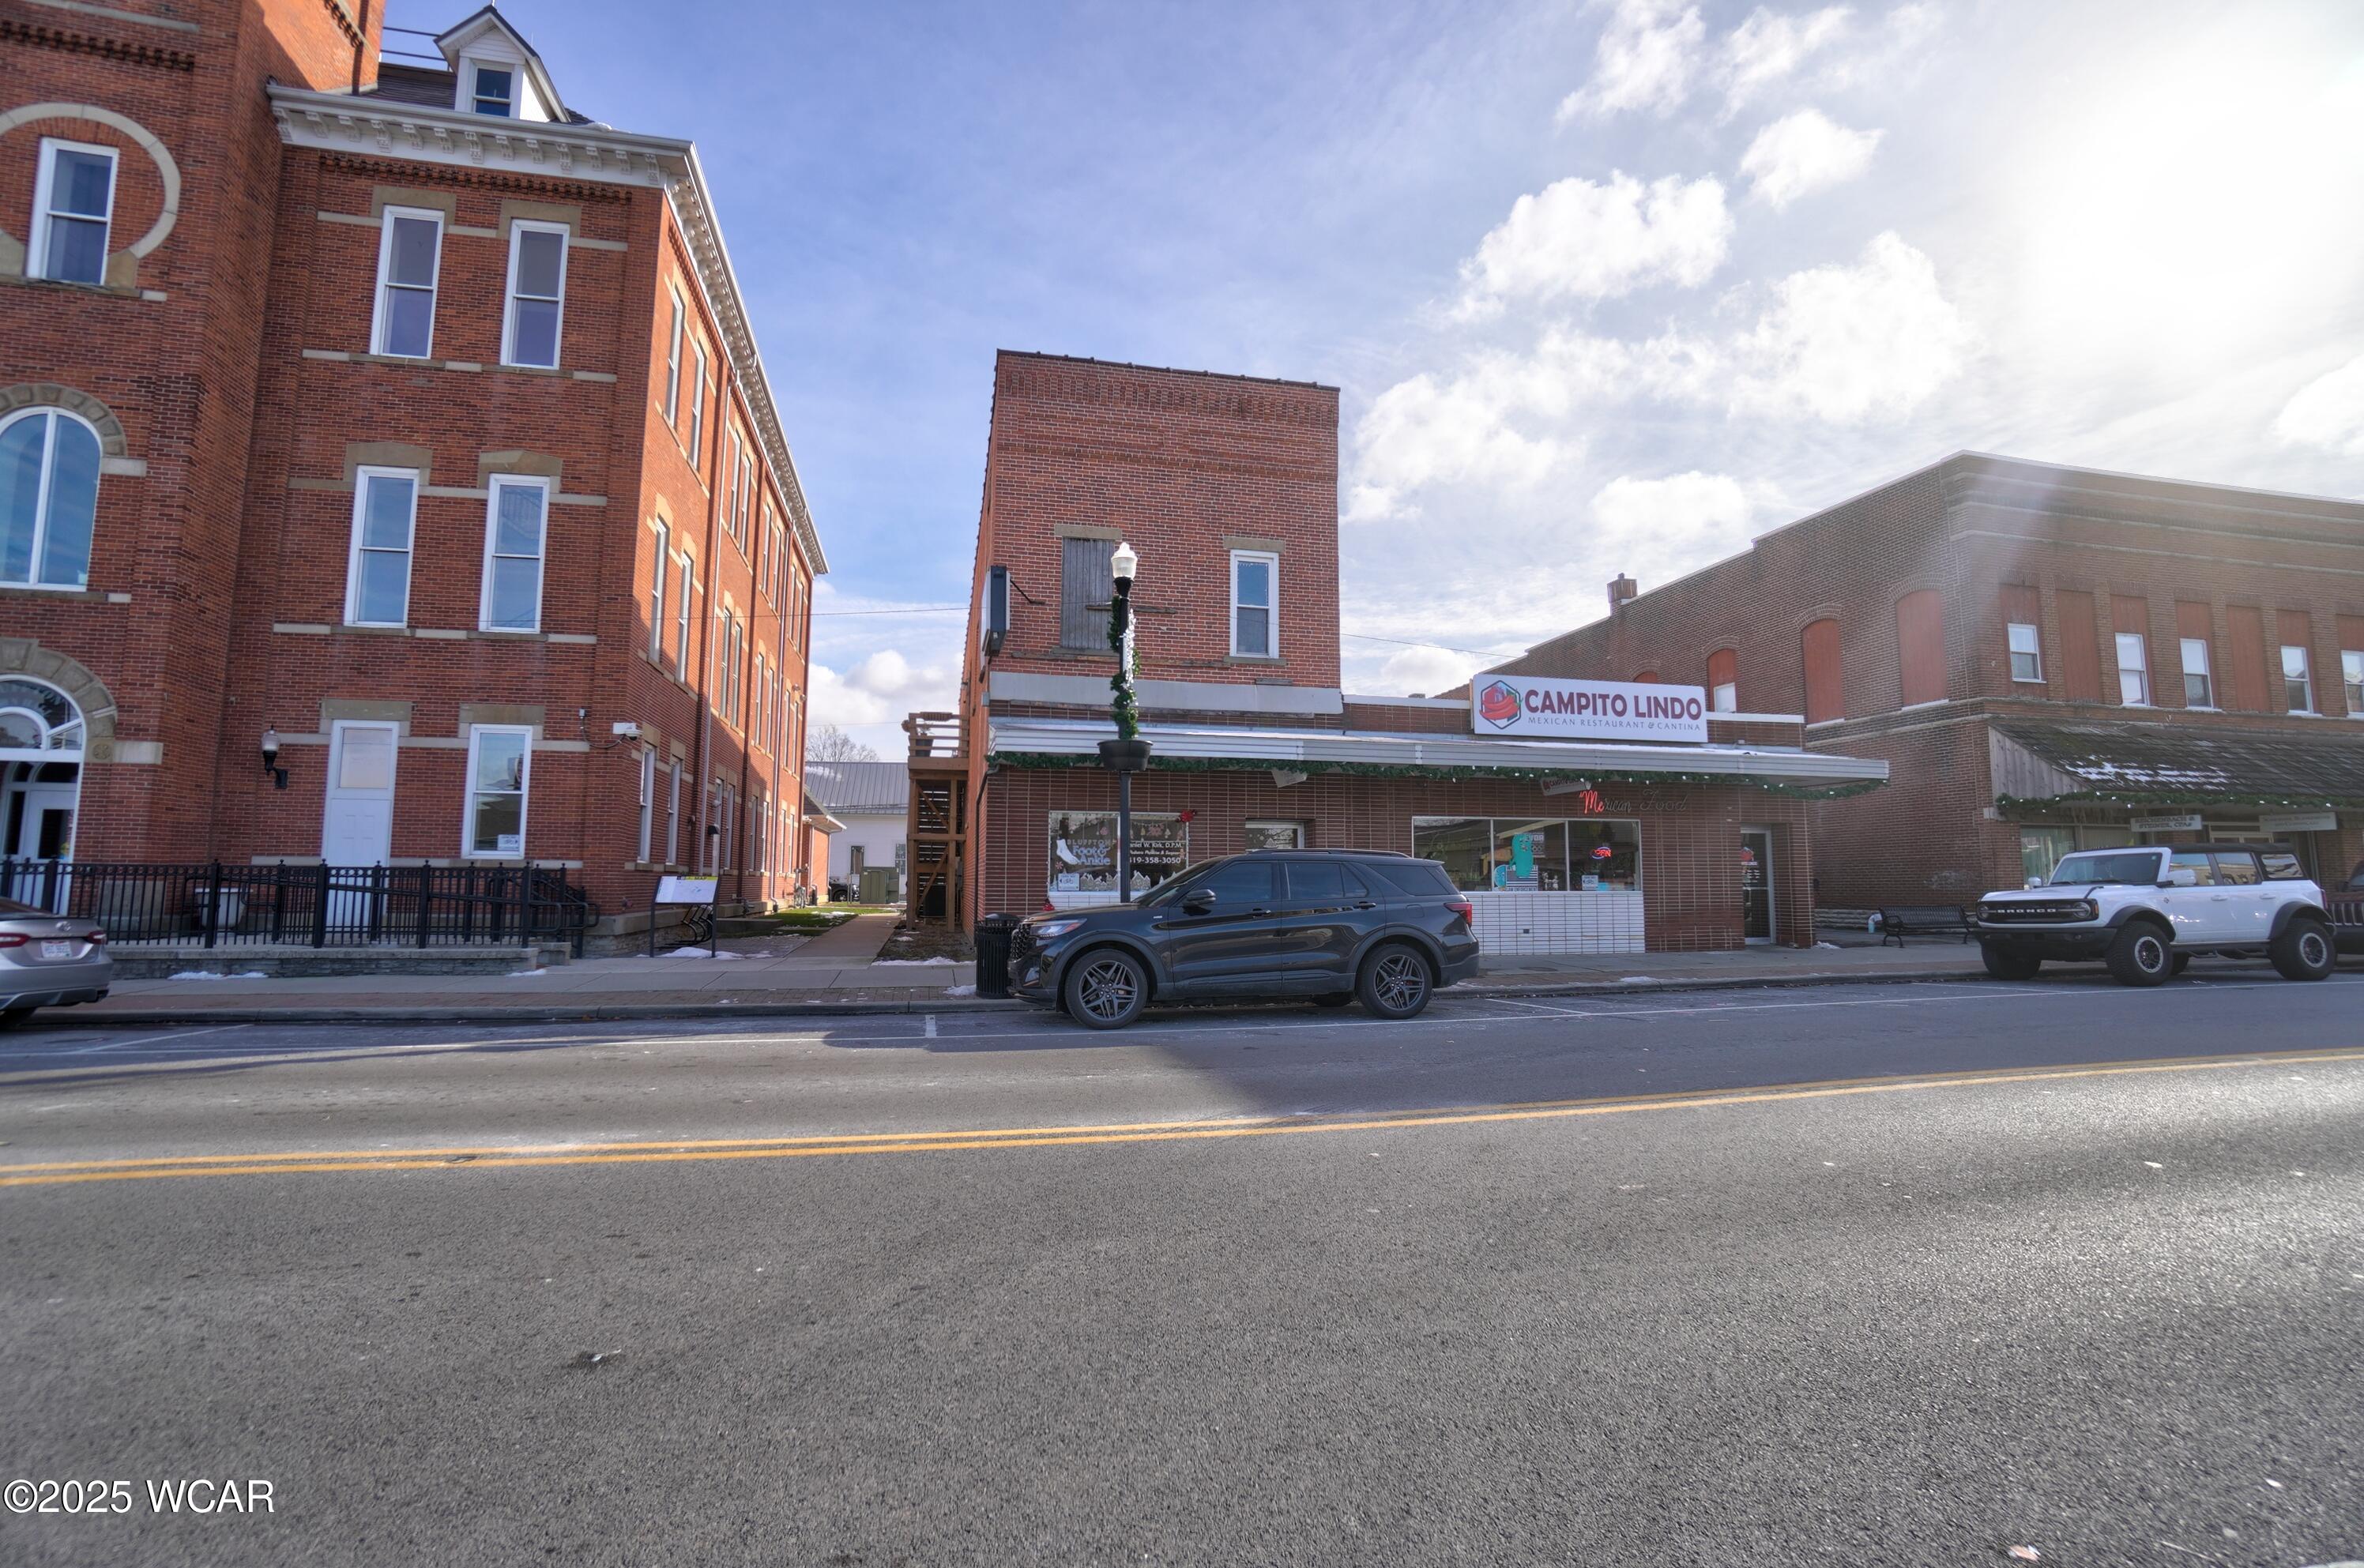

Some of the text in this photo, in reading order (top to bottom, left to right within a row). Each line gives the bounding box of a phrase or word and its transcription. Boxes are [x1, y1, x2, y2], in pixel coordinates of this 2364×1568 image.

[1524, 689, 1702, 720] CAMPITO LINDO
[1528, 716, 1575, 726] MEXICAN
[1580, 720, 1644, 729] RESTAURANT
[1657, 723, 1701, 731] CANTINA
[1579, 788, 1688, 814] Mexican Food
[1073, 845, 1097, 856] Foot
[1077, 854, 1112, 866] Ankle
